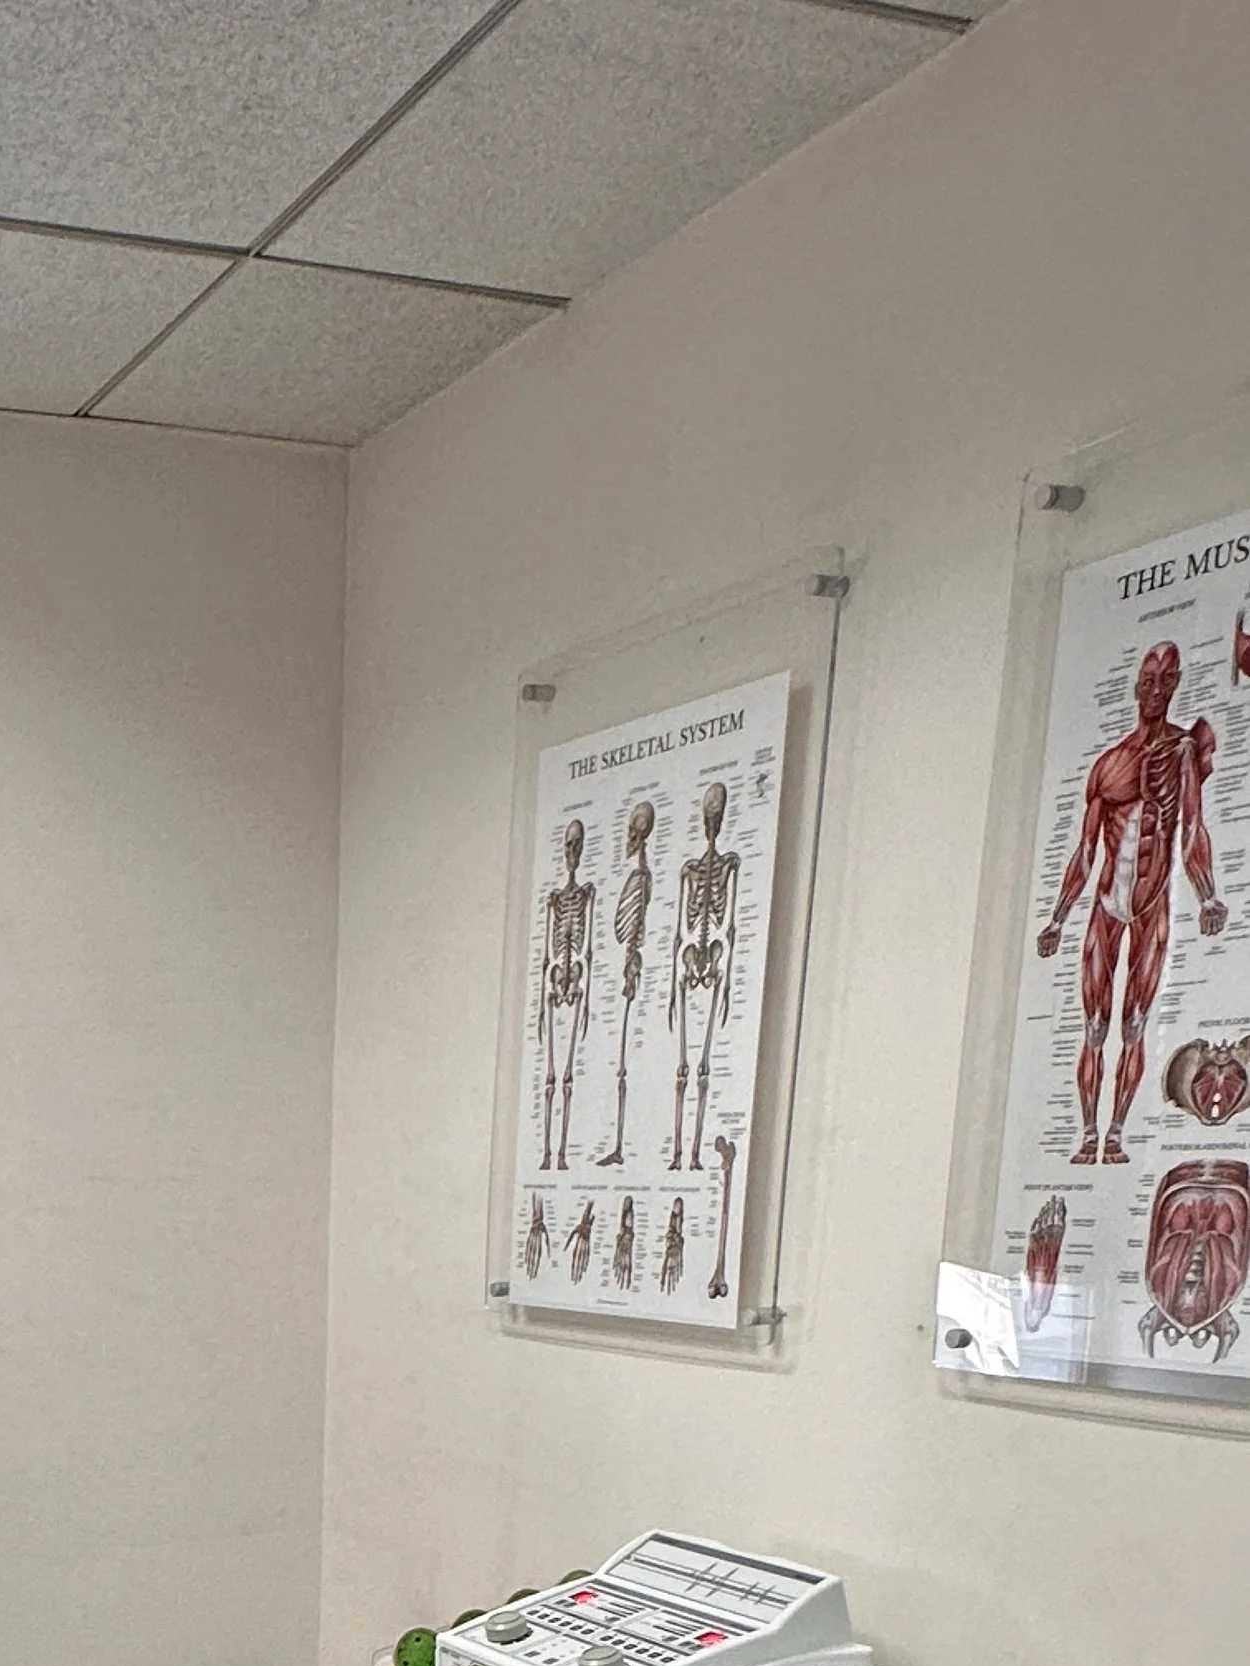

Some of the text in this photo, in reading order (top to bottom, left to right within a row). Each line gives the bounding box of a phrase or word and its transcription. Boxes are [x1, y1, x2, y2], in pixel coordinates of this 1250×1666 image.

[1116, 535, 1250, 600] THE MUS
[568, 755, 598, 780] THE
[600, 732, 675, 770] SKELETAL
[678, 708, 745, 748] SYSTEM
